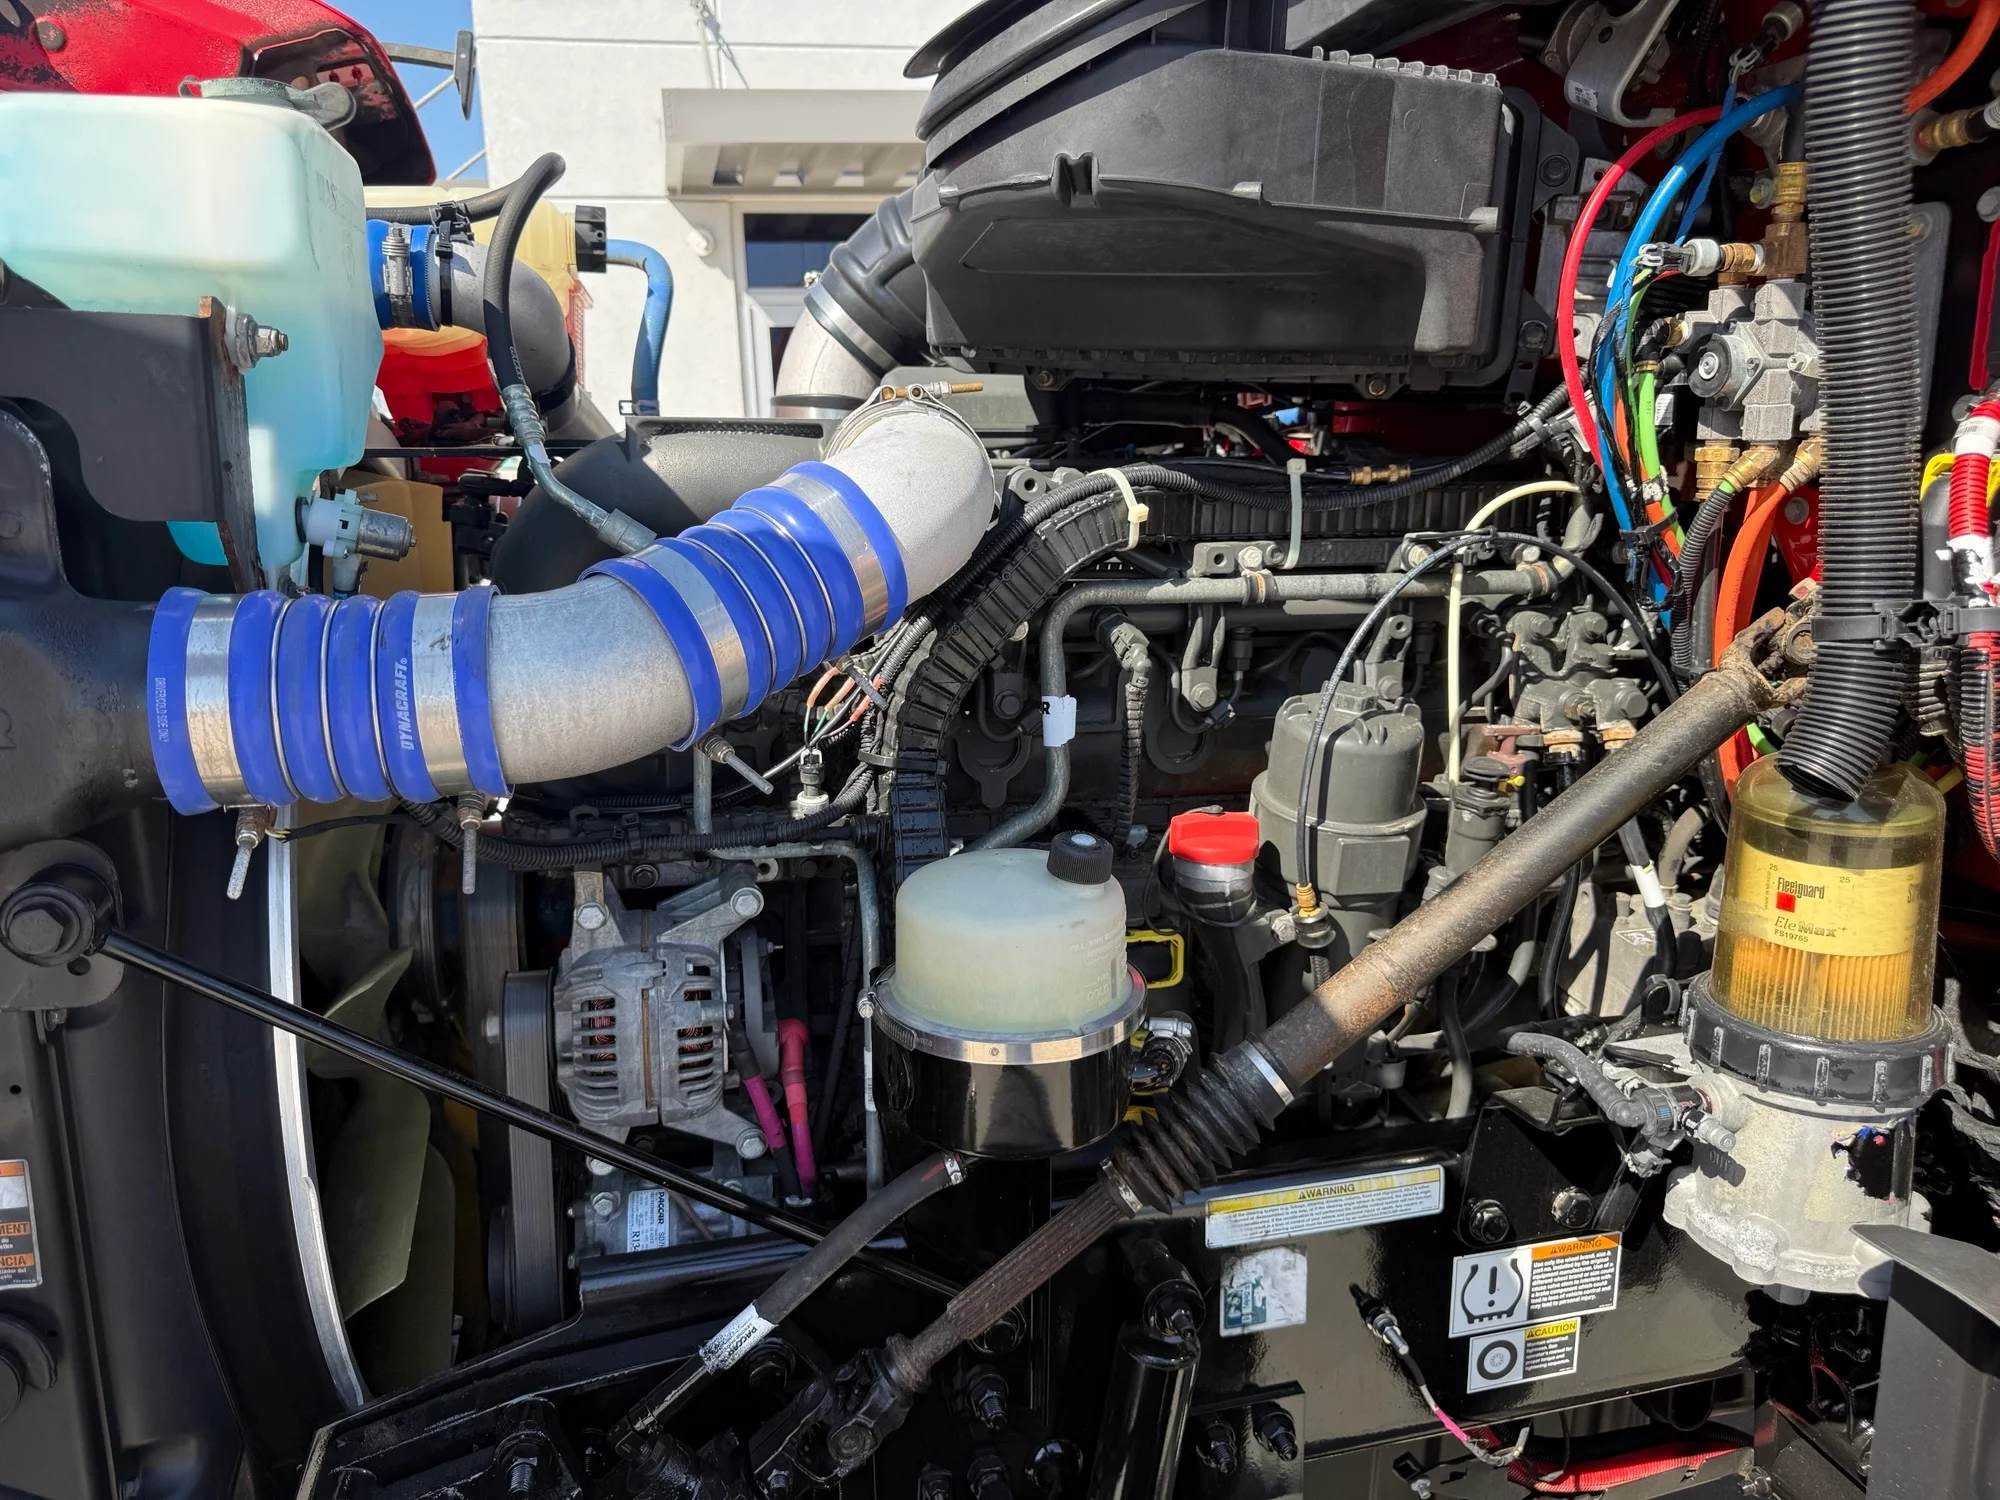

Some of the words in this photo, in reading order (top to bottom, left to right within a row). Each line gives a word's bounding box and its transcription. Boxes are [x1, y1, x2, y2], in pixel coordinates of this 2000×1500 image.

[157, 714, 169, 728] SIDE
[158, 728, 170, 743] ONLY
[1769, 863, 1778, 872] 25
[1840, 876, 1851, 884] 25
[1777, 876, 1825, 899] Fleetguard
[1774, 929, 1809, 943] FS19765
[1306, 1183, 1355, 1200] WARNING
[1557, 1240, 1601, 1252] WARNING
[1535, 1323, 1576, 1336] CAUTION
[728, 1326, 758, 1356] PACCAR
